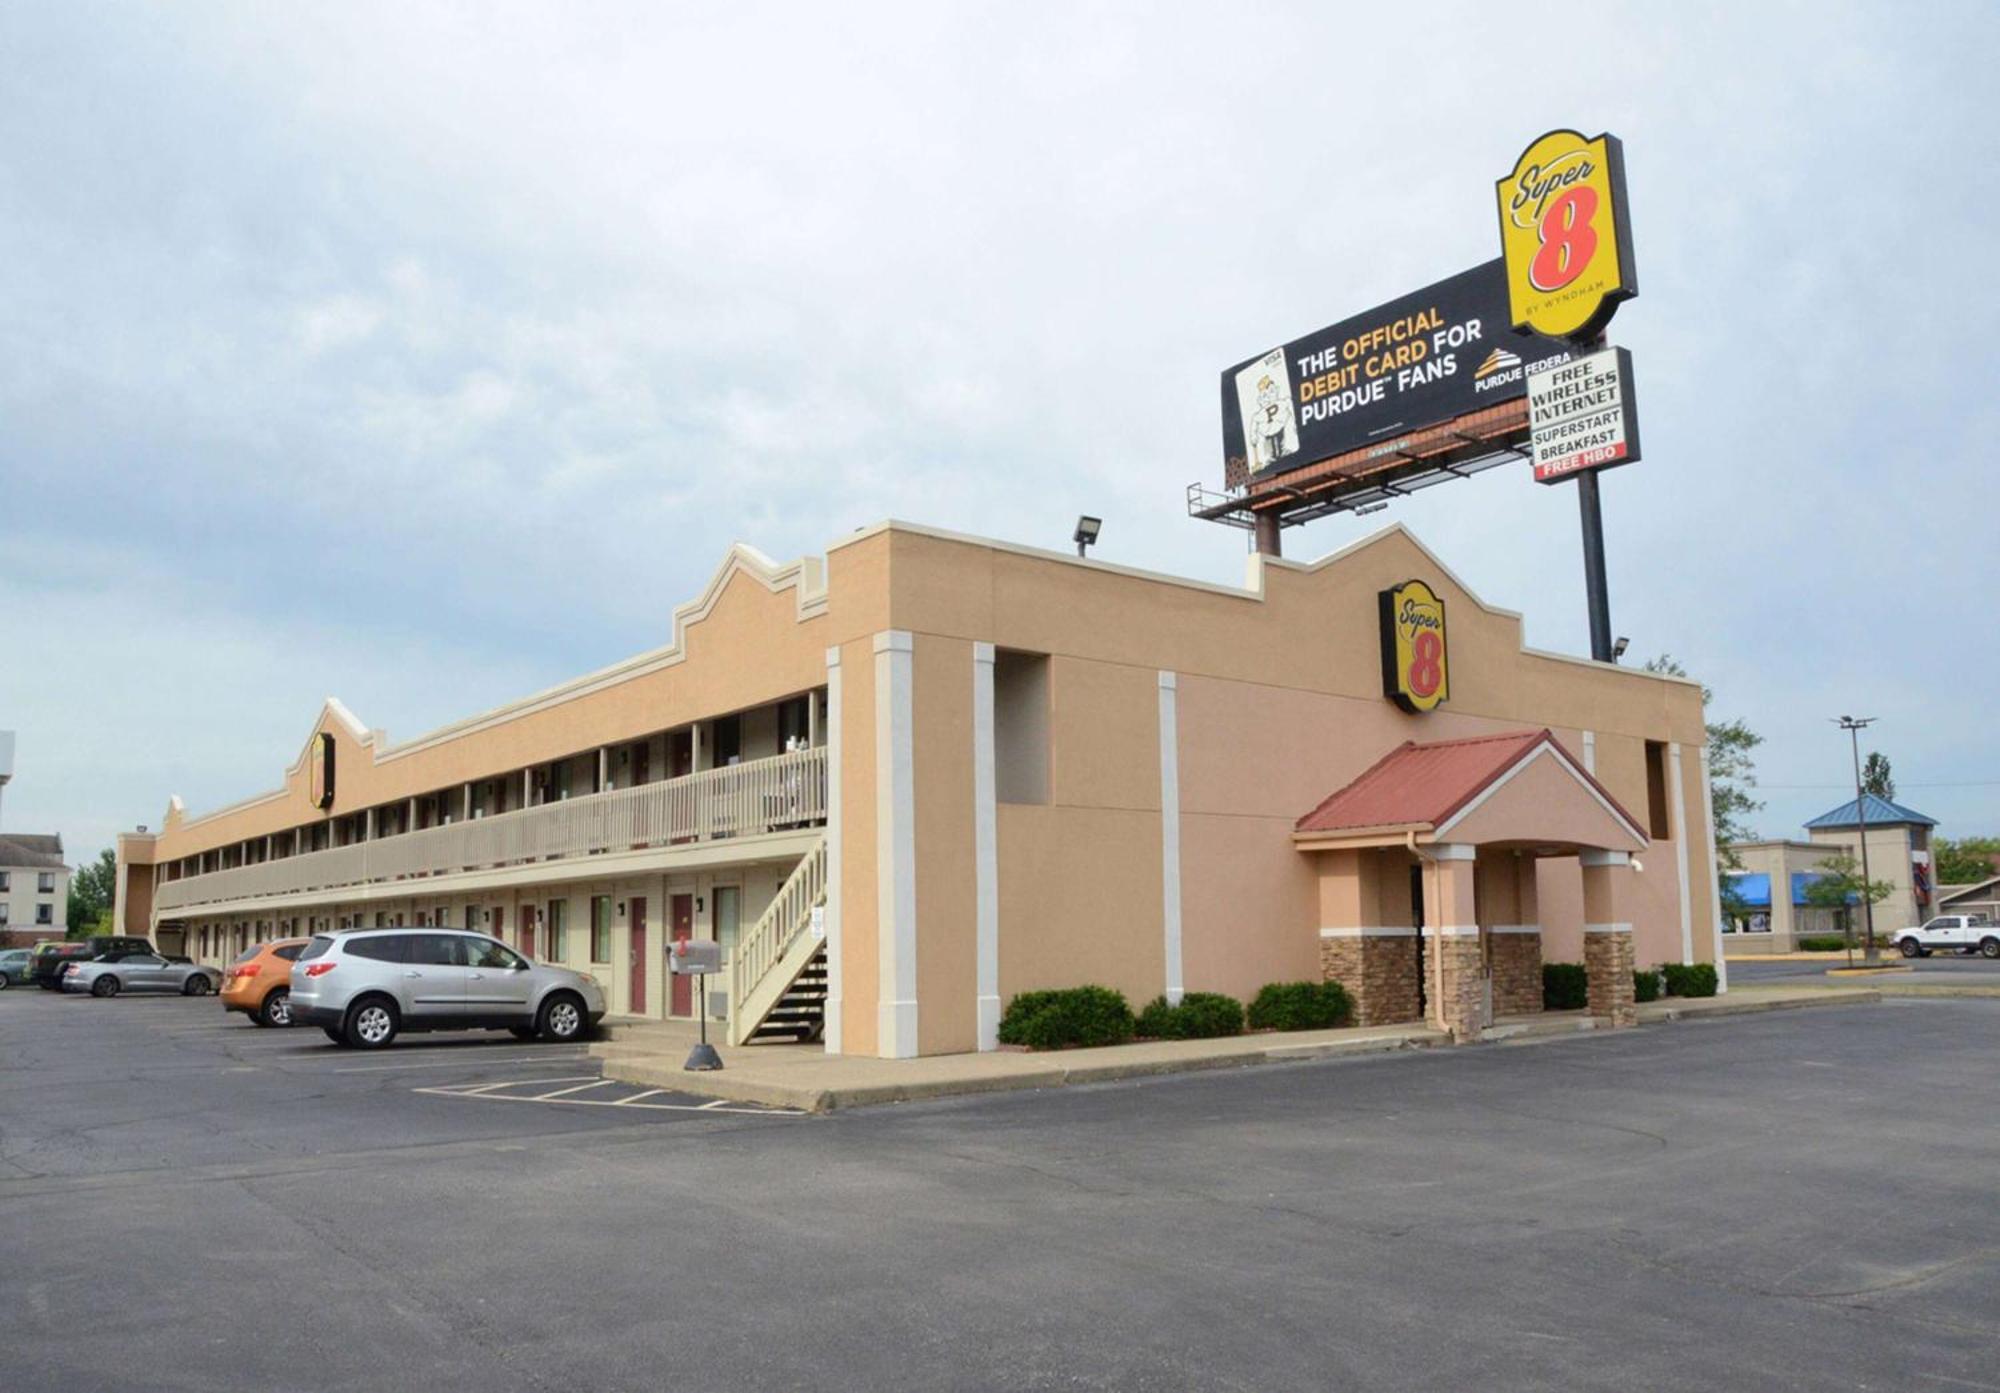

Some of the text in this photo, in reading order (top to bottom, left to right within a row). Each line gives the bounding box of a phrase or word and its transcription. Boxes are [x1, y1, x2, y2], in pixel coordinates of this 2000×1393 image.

[1511, 161, 1595, 219] Super
[1528, 186, 1598, 292] 8
[1525, 280, 1604, 316] BY WYNDHAM
[1297, 307, 1444, 377] THE OFFICIAL
[1300, 318, 1482, 402] DEBIT CARD FOR
[1398, 353, 1457, 392] FANS
[1475, 352, 1572, 393] PURDUE FEDERA
[1532, 370, 1617, 408] WIRELESS
[1552, 361, 1592, 387] FREE
[1534, 387, 1616, 423] INTERNET
[1535, 410, 1620, 445] SUPERSTART
[1541, 428, 1616, 460] BREAKFAST
[1543, 446, 1616, 476] FREE HBO
[1400, 599, 1440, 638] Super
[1408, 631, 1442, 698] 8
